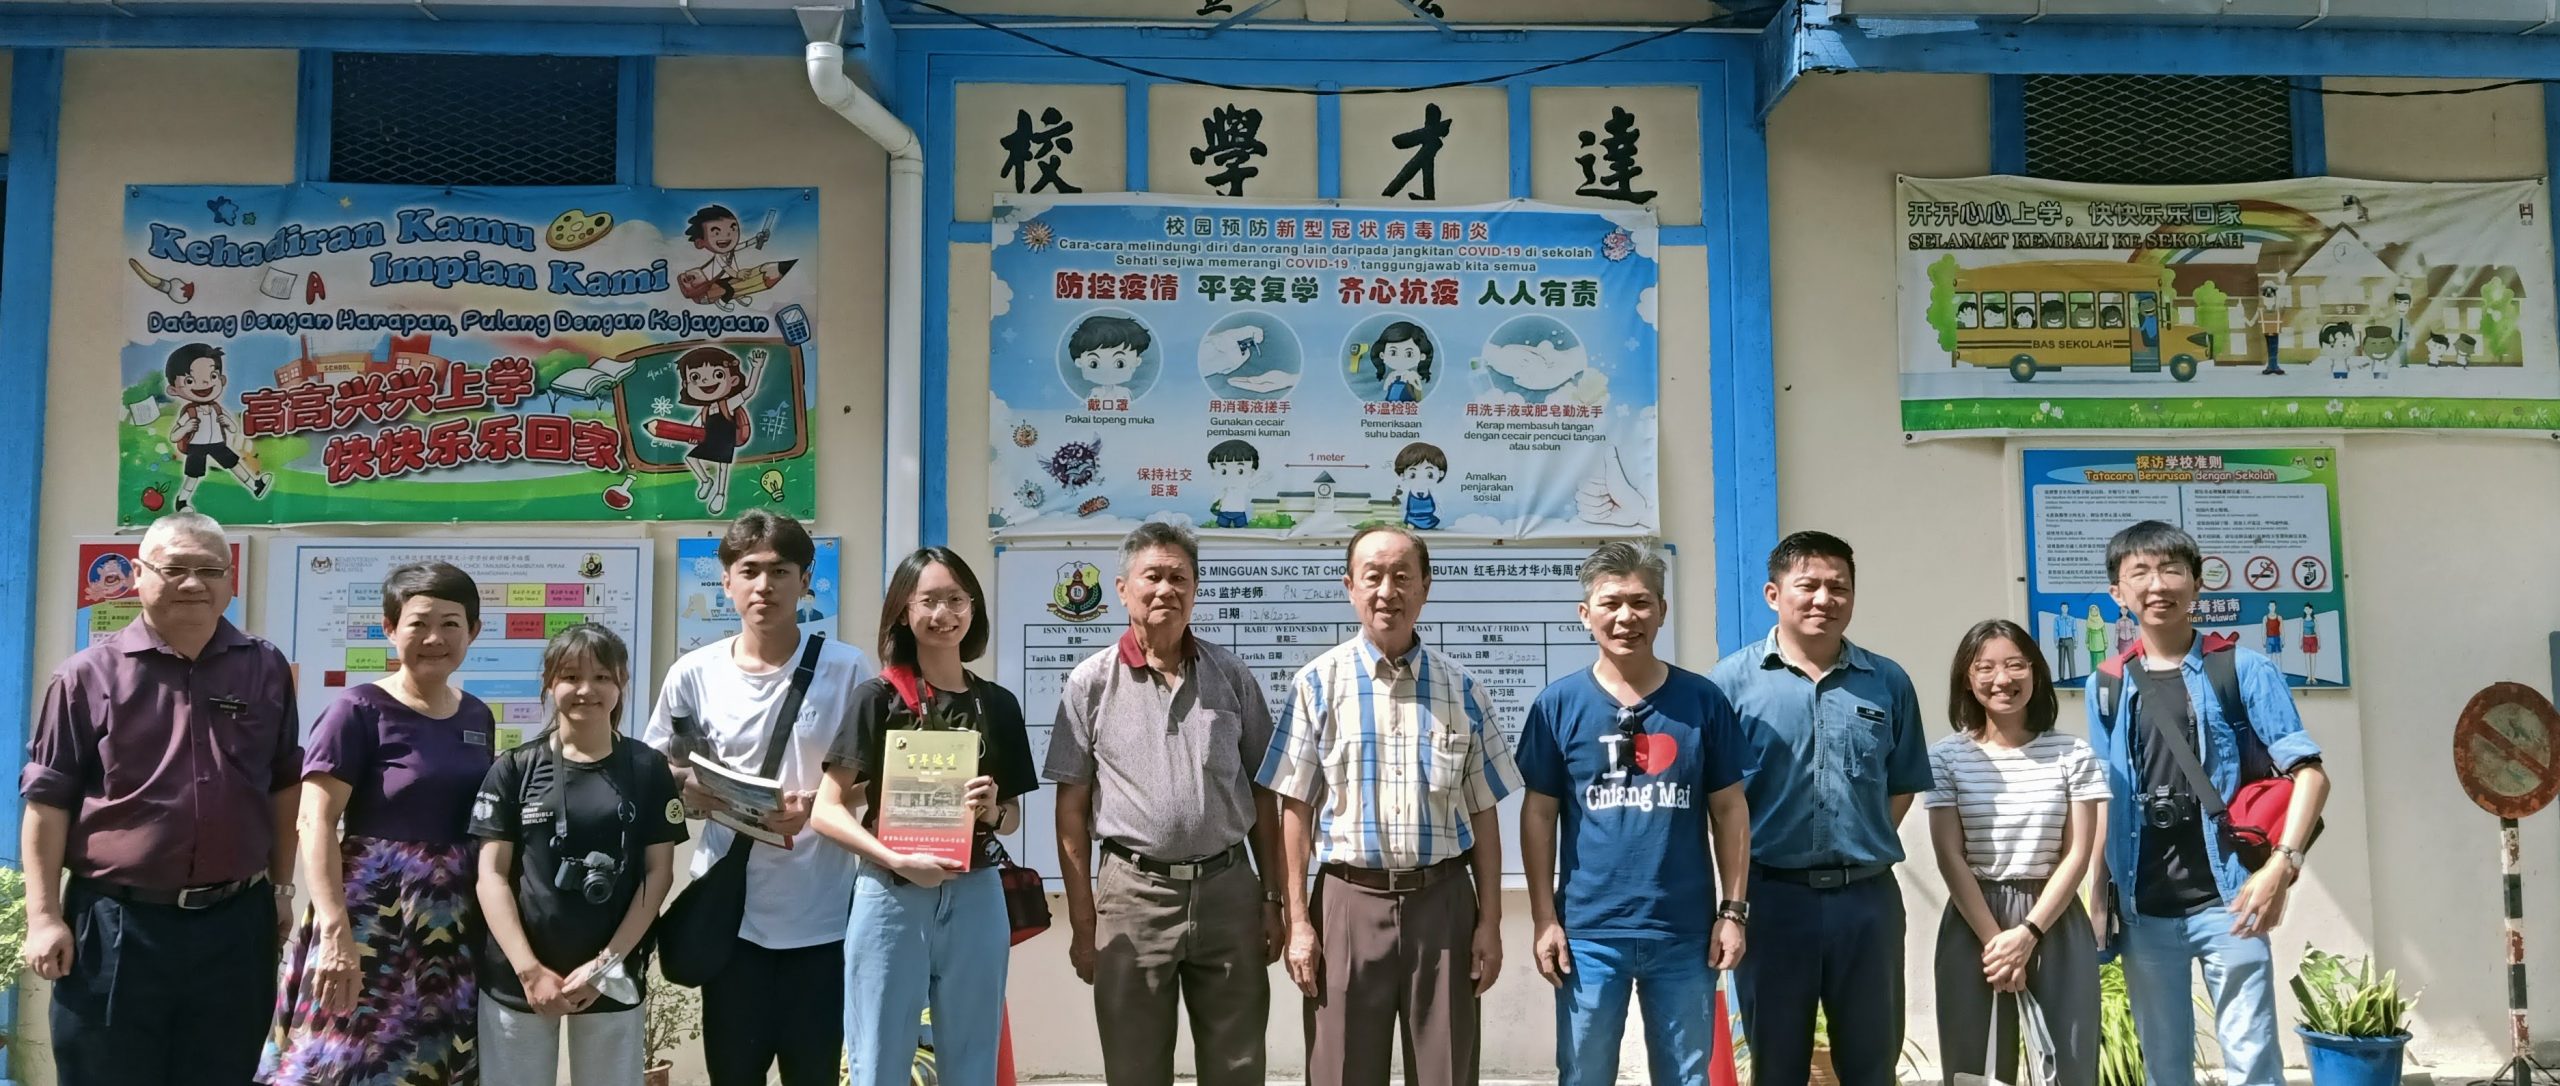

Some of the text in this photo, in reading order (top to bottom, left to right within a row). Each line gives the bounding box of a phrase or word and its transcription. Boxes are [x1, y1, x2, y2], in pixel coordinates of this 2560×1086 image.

[1001, 102, 1658, 203] 校 學 才 達
[1165, 217, 1489, 241] 校园预防新型冠状病毒肺炎
[148, 208, 537, 267] Kehadiran Kamu
[1908, 232, 2245, 250] SELAMAT KEMBALI KE SEKOLAH
[1059, 238, 1593, 258] Cara-cara melindungi diri dan orang lain daripada jangkitan COVID-19 di sekolah
[1116, 255, 1536, 273] Sehati sejiwa memerangi COVID-19 tanggungjawab kita semua
[371, 250, 670, 297] Impian Kami
[1056, 272, 1598, 307] 防控疫情 平安复学 齐心抗疫 人人有责
[147, 308, 769, 337] Datang Dengan Harapan, Pulang Dengan Kejayaan
[2032, 339, 2113, 350] BAS SEKOLAH
[323, 362, 352, 371] SCHOOL
[241, 356, 537, 437] 高高兴兴上学
[1087, 399, 1129, 413] 戴口罩
[1208, 400, 1292, 414] 用消毒液搓手
[1363, 402, 1419, 416] 体温检验
[1466, 403, 1604, 418] 用洗手液或肥皂勤洗手
[1064, 415, 1155, 426] Pakai topeng muka
[1210, 417, 1285, 427] Gunakan cecair
[1360, 418, 1422, 429] Pemeriksaan
[1476, 420, 1594, 434] Kerap membasuh tangan
[1206, 428, 1291, 438] pembasmi kuman
[1364, 429, 1420, 438] suhu badan
[1464, 431, 1606, 443] dengan cecair pencuci tangan
[323, 414, 622, 484] 快快乐乐回家
[1509, 442, 1561, 452] atau sabun
[1308, 453, 1345, 462] 1 meter
[2136, 455, 2223, 470] 探访学校准则
[1137, 467, 1193, 481] 保持社交
[1465, 472, 1507, 481] Amalkan
[2085, 470, 2276, 484] Tatacara Berurusan dengan Sekolah
[1151, 484, 1179, 497] 距离
[1460, 483, 1514, 494] penjarakan
[1473, 493, 1502, 502] sosial
[1209, 566, 1268, 576] MINGGUAN
[1271, 566, 1298, 576] SJKC
[1302, 566, 1320, 576] TAT
[1323, 566, 1347, 576] CHO
[1431, 566, 1468, 576] BUTAN
[2205, 613, 2238, 623] Pelawat
[1073, 626, 1112, 634] MONDAY
[1456, 625, 1530, 633] JUMAAT FRIDAY
[1067, 636, 1089, 645] 星期一
[1032, 654, 1056, 662] Tarikh
[1448, 651, 1472, 659] Tarikh
[1489, 688, 1515, 697] 补习班
[1598, 734, 1627, 780] I
[1585, 781, 1691, 813] Chiang Mai
